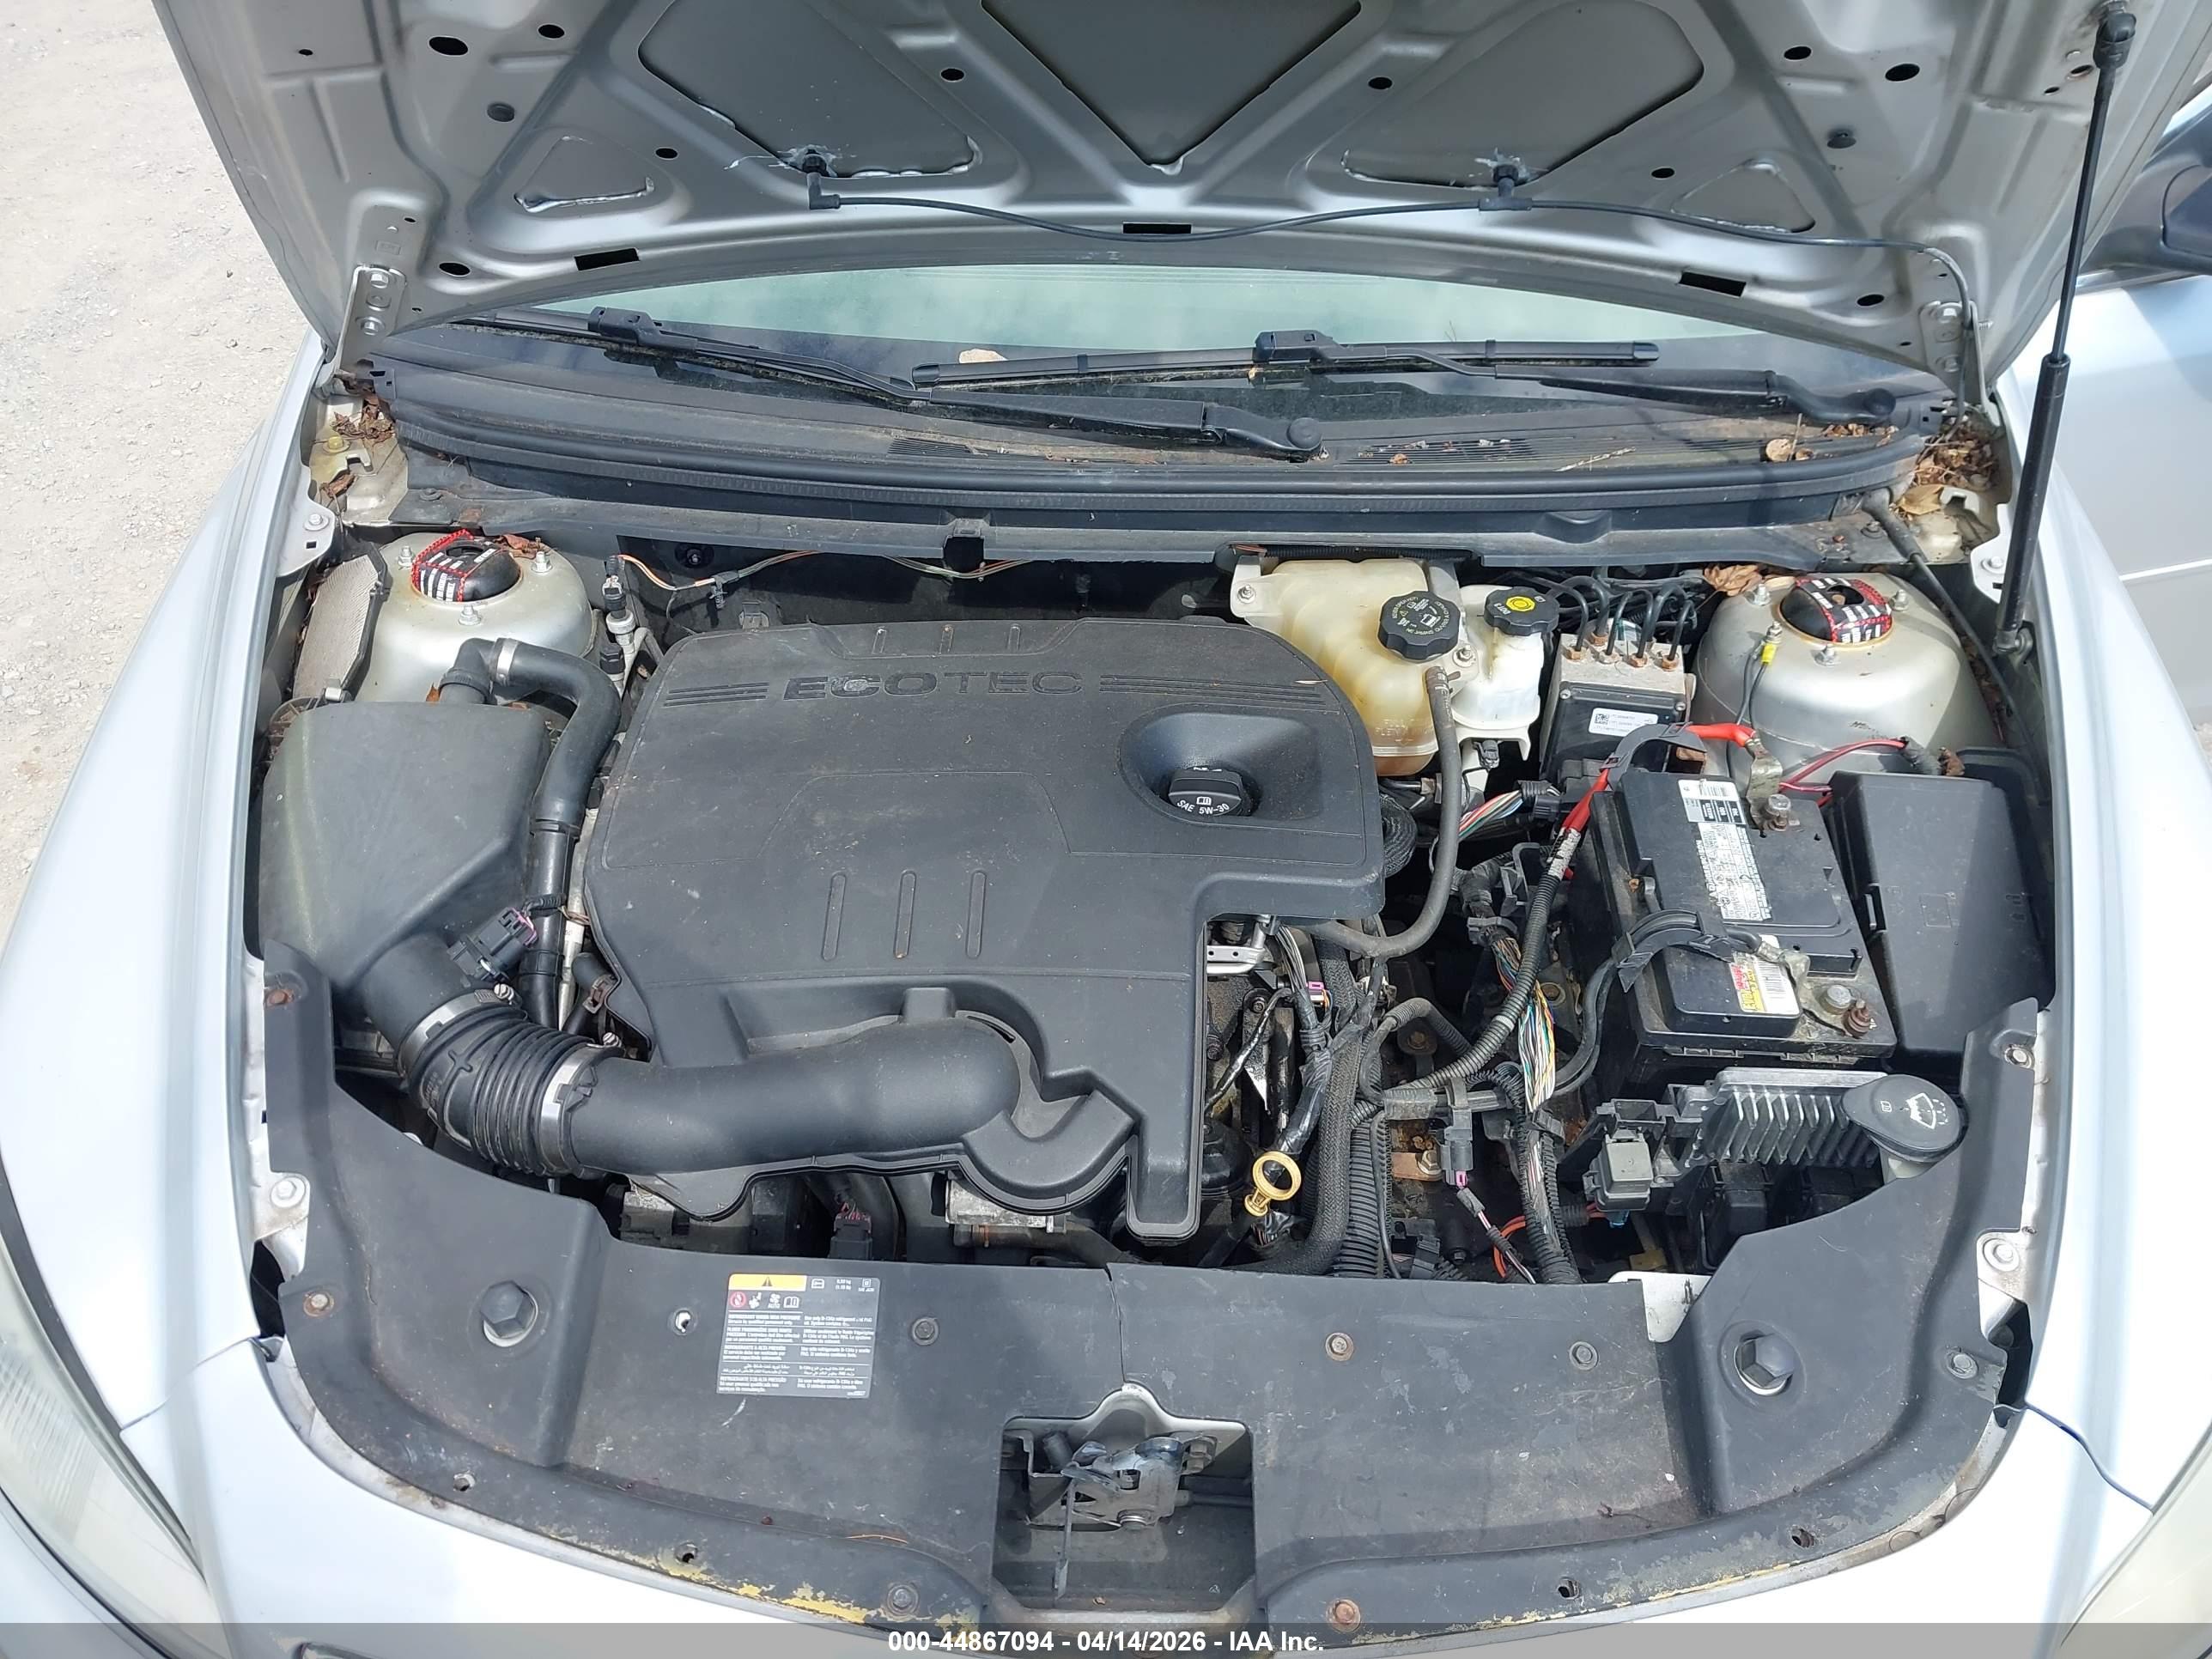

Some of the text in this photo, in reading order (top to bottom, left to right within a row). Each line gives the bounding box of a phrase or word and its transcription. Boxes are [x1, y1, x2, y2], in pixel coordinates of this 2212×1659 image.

[782, 672, 1083, 701] ECOTEC
[1176, 799, 1230, 815] SAE 5W-30
